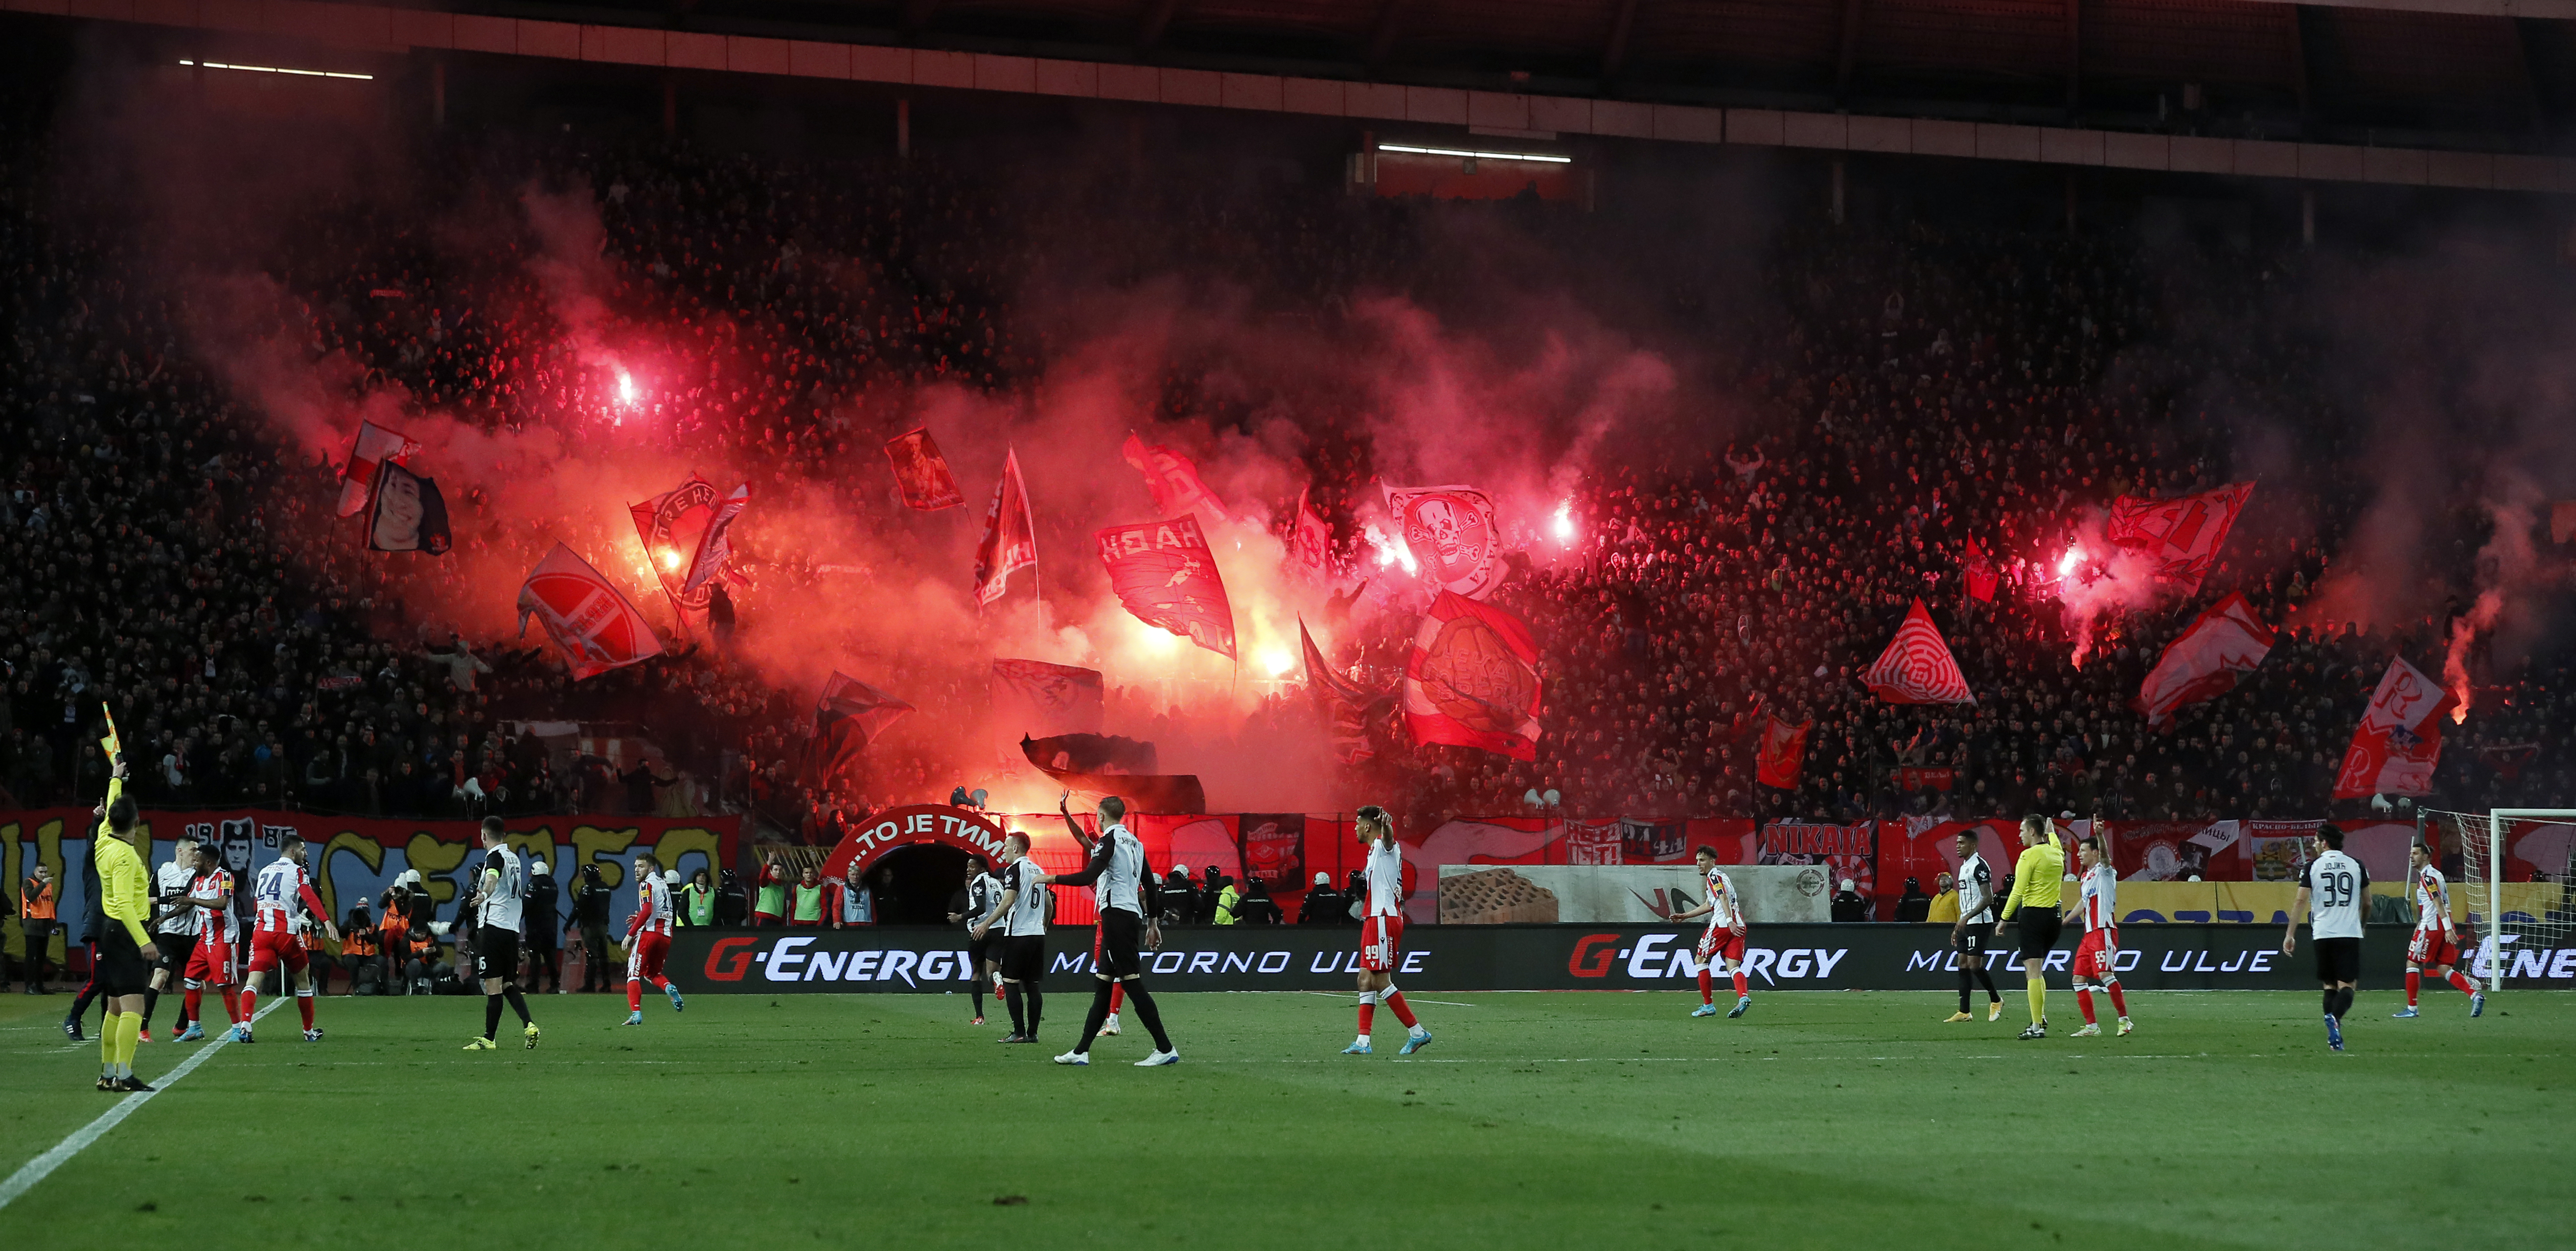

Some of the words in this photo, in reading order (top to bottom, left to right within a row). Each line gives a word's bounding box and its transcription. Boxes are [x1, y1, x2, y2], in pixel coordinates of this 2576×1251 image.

[904, 814, 933, 834] ЈЕ
[2122, 823, 2175, 842] ГОРДОСТЬ
[2178, 823, 2230, 842] СТОЛИЦЫ
[1764, 825, 1871, 856] NIKAIA
[256, 872, 284, 901] 24
[2321, 872, 2353, 907] 39
[1967, 935, 1976, 947] 11
[1050, 951, 1291, 973] MORNO
[1310, 951, 1431, 973] ULE
[1365, 945, 1379, 960] 99
[1906, 950, 2142, 972] MTORO
[2161, 950, 2279, 972] ULJE
[2094, 951, 2106, 964] 55
